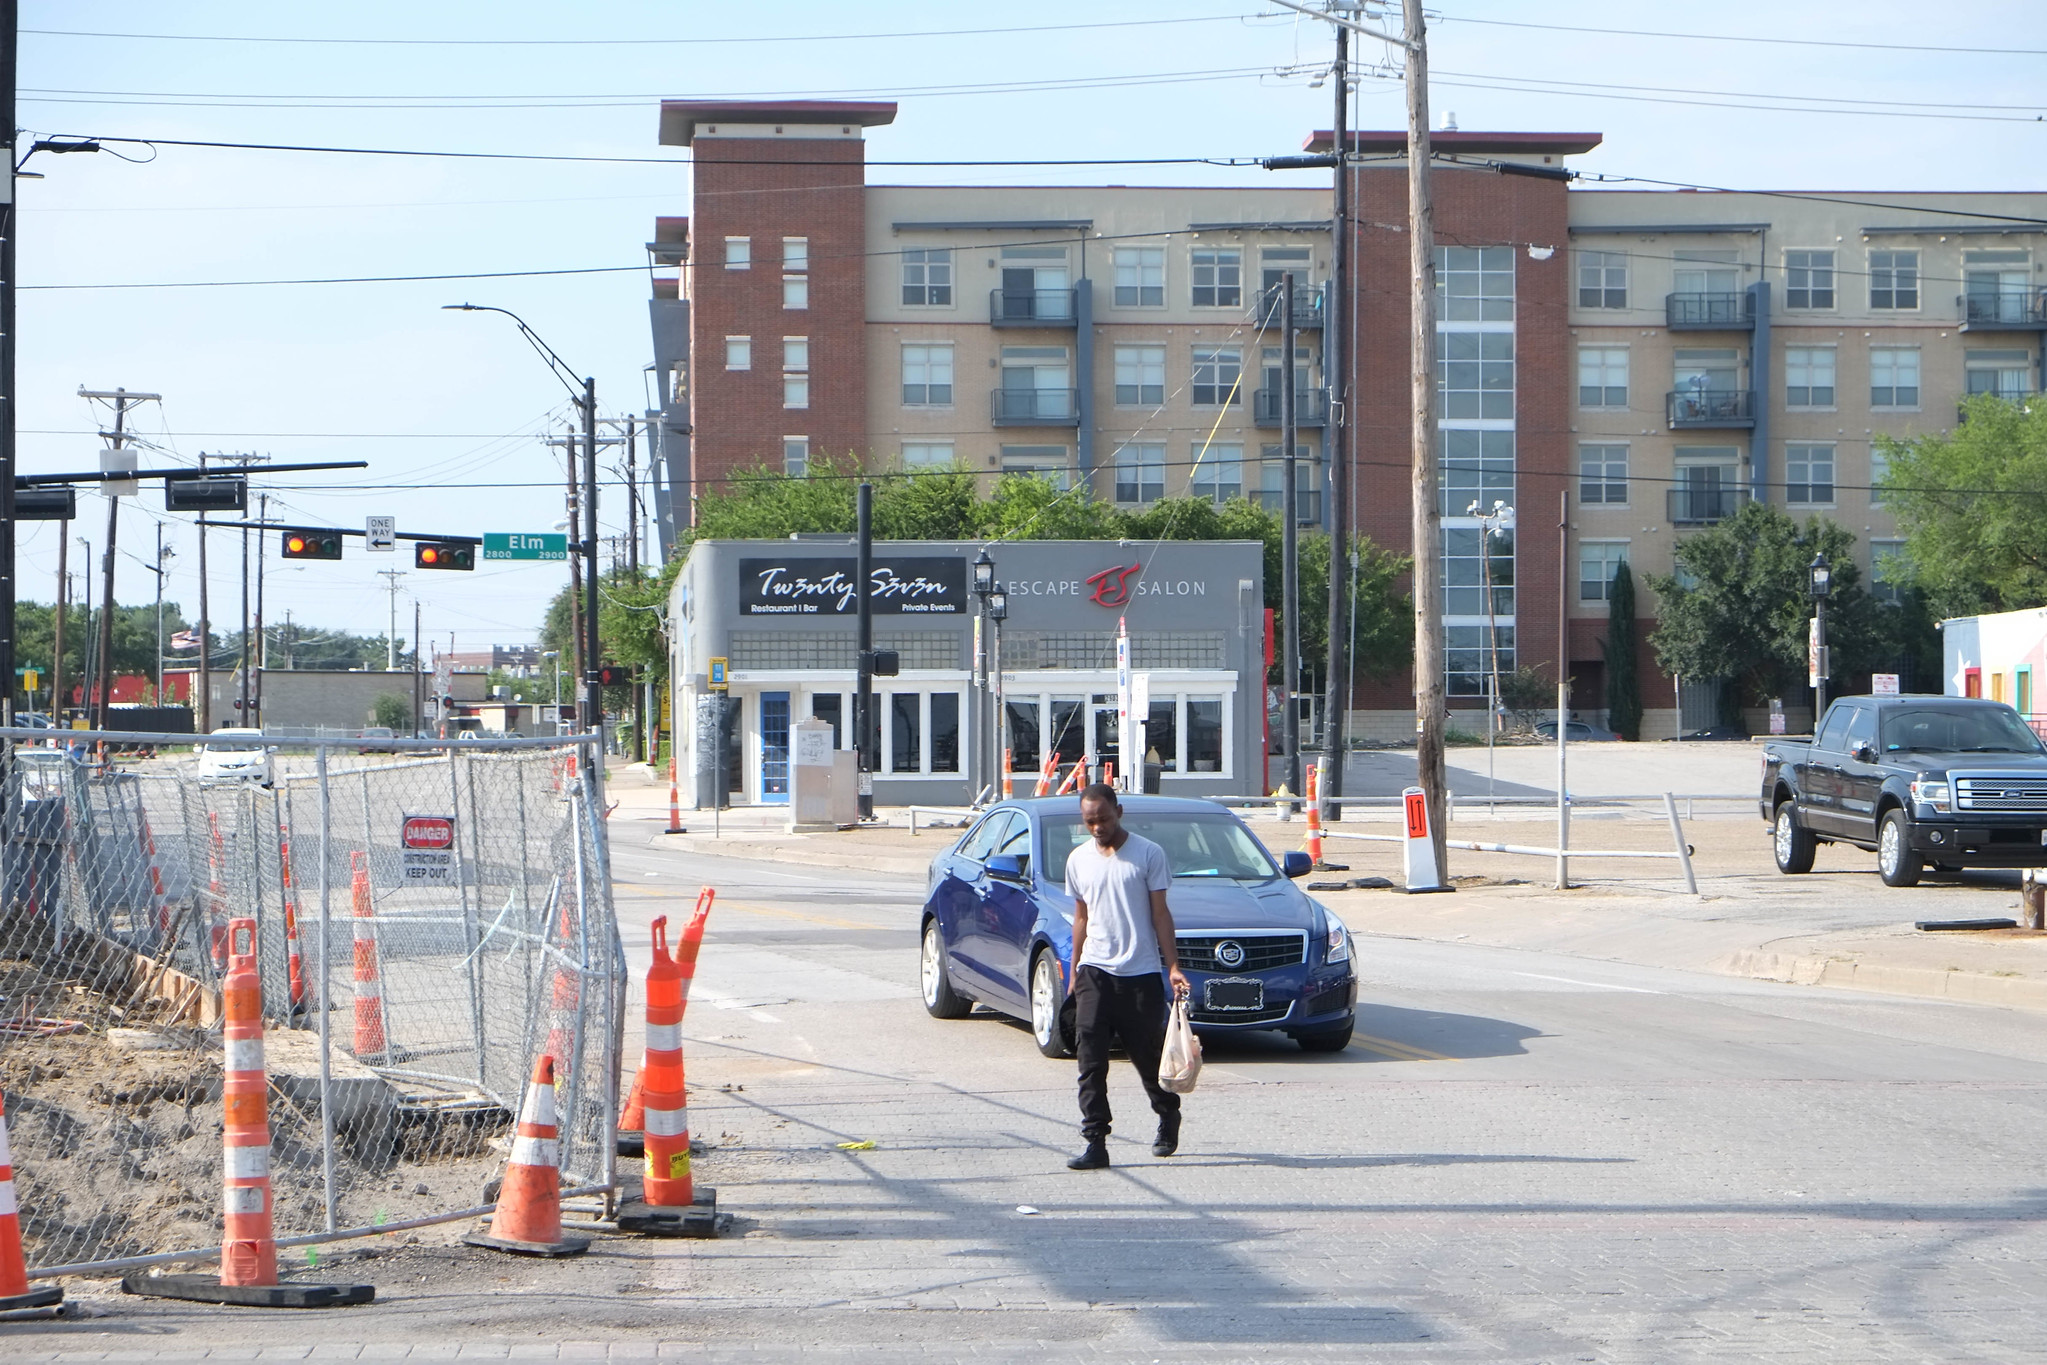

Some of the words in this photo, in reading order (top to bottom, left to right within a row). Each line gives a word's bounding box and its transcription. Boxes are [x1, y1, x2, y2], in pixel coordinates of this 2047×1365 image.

[371, 519, 390, 527] ONE
[371, 529, 391, 537] WAY
[509, 535, 544, 549] Elm
[485, 550, 512, 559] 2800
[538, 551, 565, 559] 2900
[1008, 581, 1080, 596] ESCAPE
[1137, 581, 1206, 596] SALON
[751, 604, 798, 613] Restaurant
[803, 604, 818, 612] Bar
[902, 603, 929, 612] Private
[930, 603, 956, 612] Events
[406, 826, 450, 840] DANGER
[405, 867, 427, 879] KEEP
[429, 867, 447, 879] OUT
